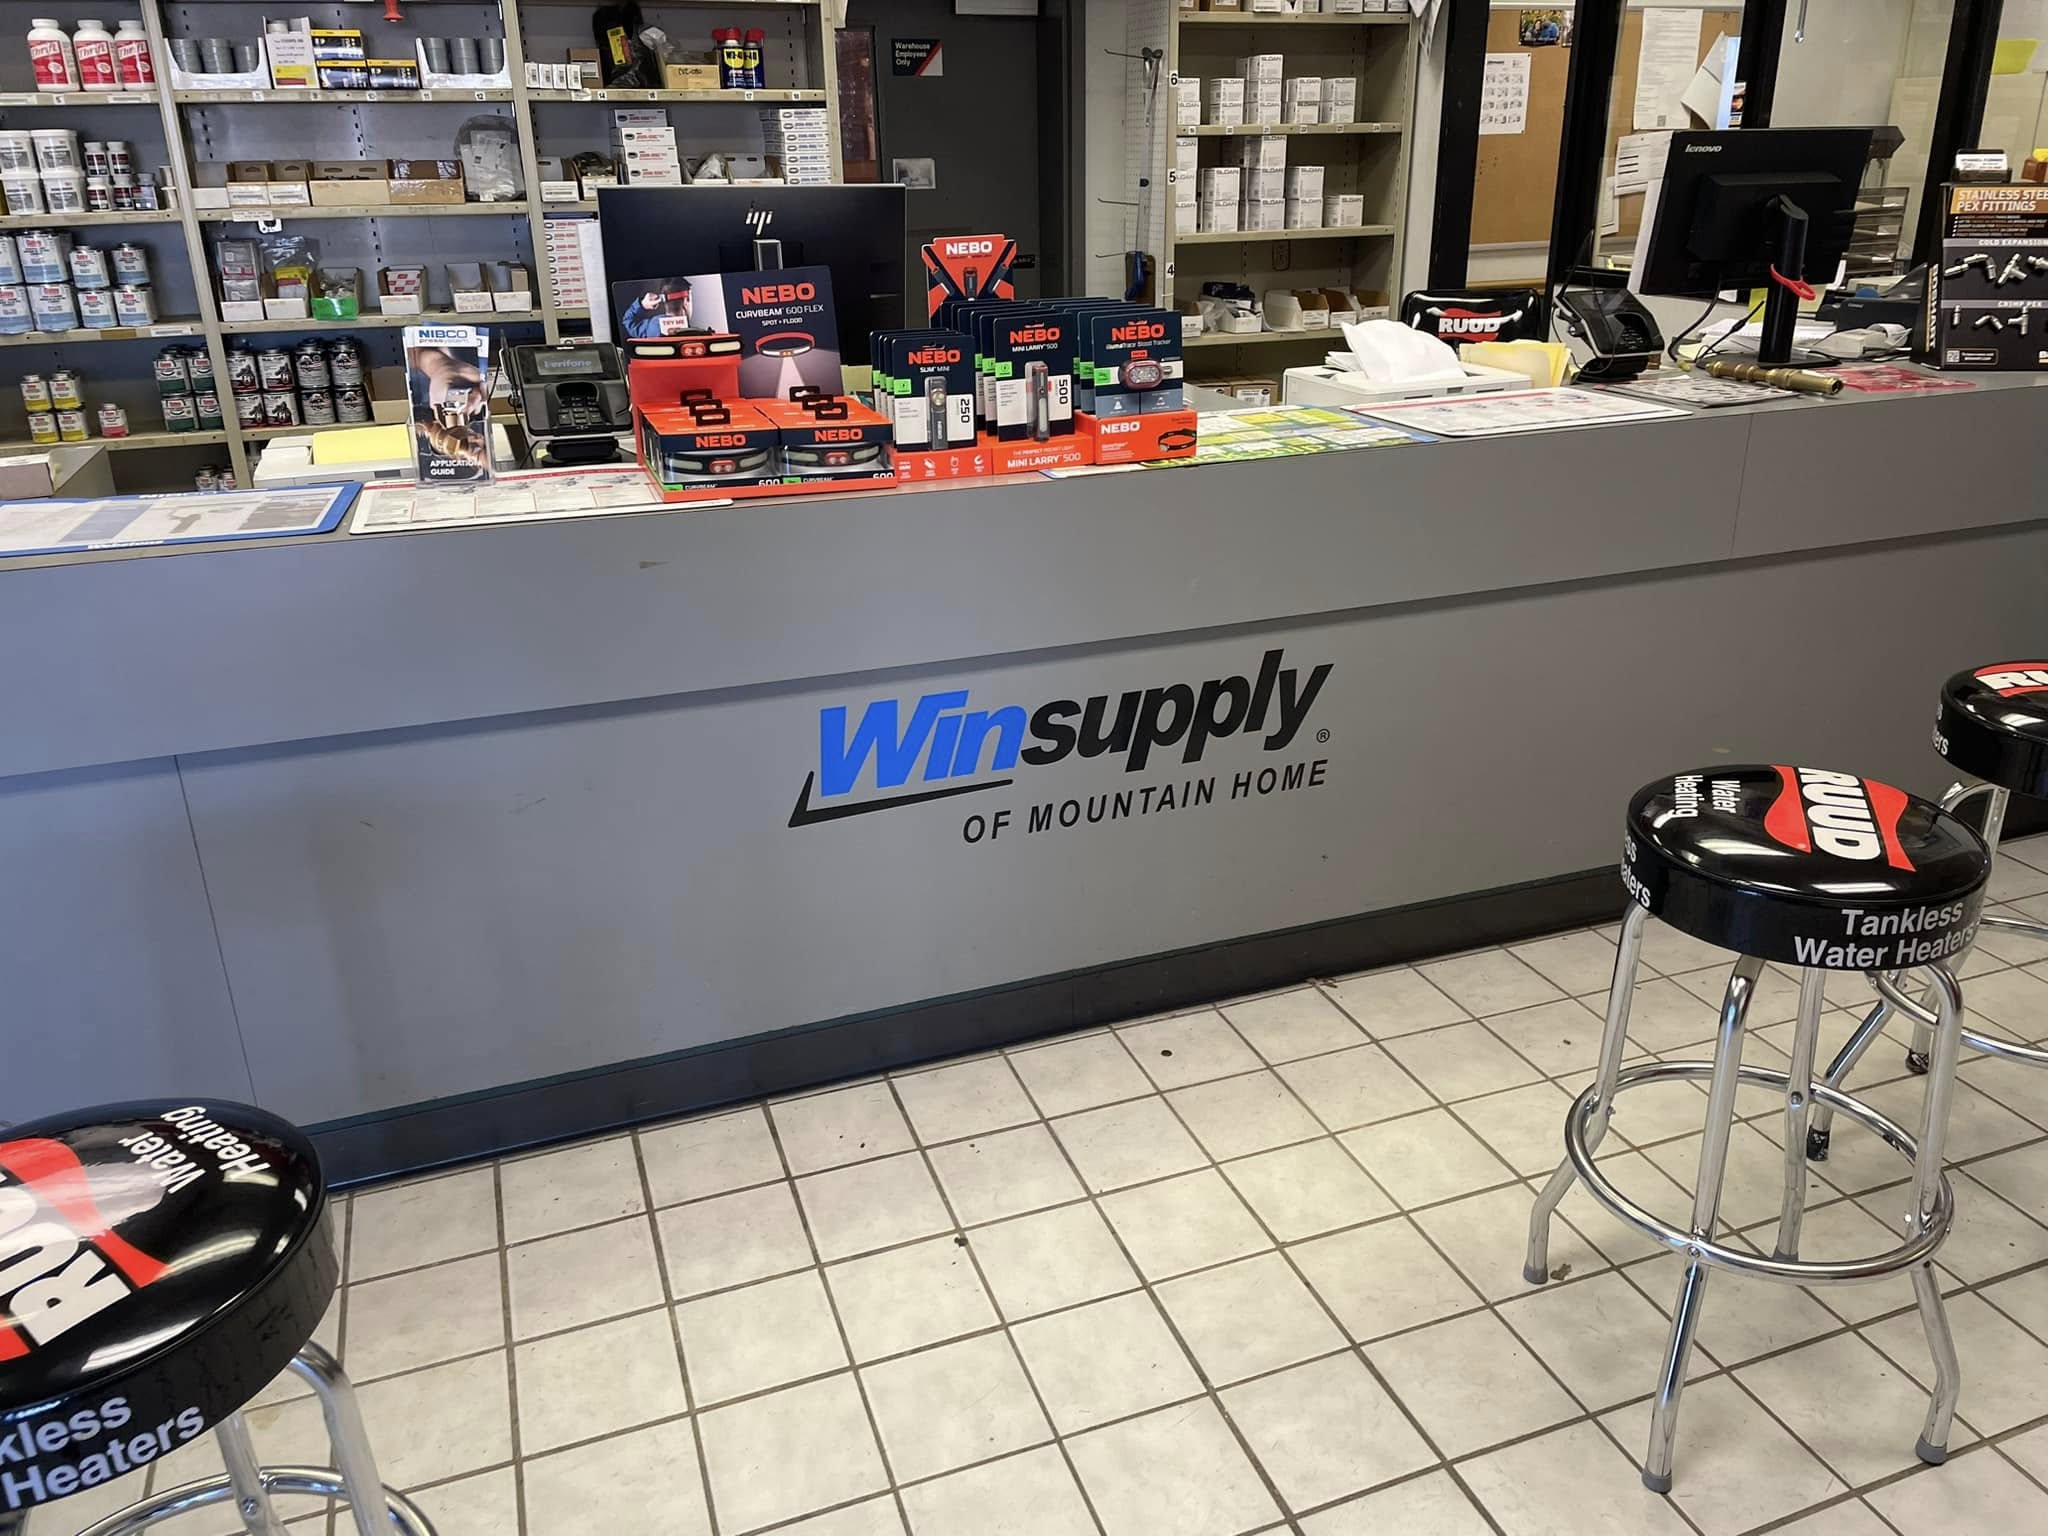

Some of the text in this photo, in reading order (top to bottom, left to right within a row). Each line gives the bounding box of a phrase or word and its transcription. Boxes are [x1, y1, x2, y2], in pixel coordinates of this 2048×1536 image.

[31, 42, 60, 58] Thrift
[79, 42, 107, 58] Thrift
[896, 59, 910, 67] Only
[1171, 73, 1178, 85] 6
[1685, 143, 1722, 152] lenovo
[1169, 171, 1176, 183] 5
[1958, 189, 2020, 201] STAINLESS
[1956, 200, 2037, 211] PEX FITTINGS
[945, 241, 993, 255] NEBO
[1167, 264, 1176, 276] 4
[741, 282, 816, 305] NEBO
[785, 305, 803, 314] 600
[803, 303, 824, 313] FLEX
[783, 317, 803, 325] FLOOD
[1439, 317, 1500, 333] RUUD
[418, 329, 468, 339] NIBCO
[1009, 327, 1061, 344] NEBO
[1111, 324, 1165, 341] NEBO
[1025, 343, 1044, 352] LARRY
[1046, 342, 1058, 350] 500
[908, 349, 961, 365] NEBO
[1059, 378, 1069, 405] 500
[960, 398, 970, 424] 250
[814, 428, 863, 442] NEBO
[1100, 421, 1142, 435] NEBO
[695, 434, 747, 448] NEBO
[1007, 452, 1082, 469] MINI LARRY 500
[820, 648, 1335, 798] Winsupply
[963, 759, 1328, 844] OF MOUNTAIN HOME
[1669, 774, 1706, 818] Heating
[1711, 780, 1742, 814] Water
[1798, 766, 1881, 861] RUUD
[1841, 902, 1964, 936] Tankless
[1794, 921, 1975, 968] Water Heaters
[160, 1106, 271, 1180] Heating
[118, 1131, 206, 1194] Water
[1, 1406, 205, 1510] Heaters
